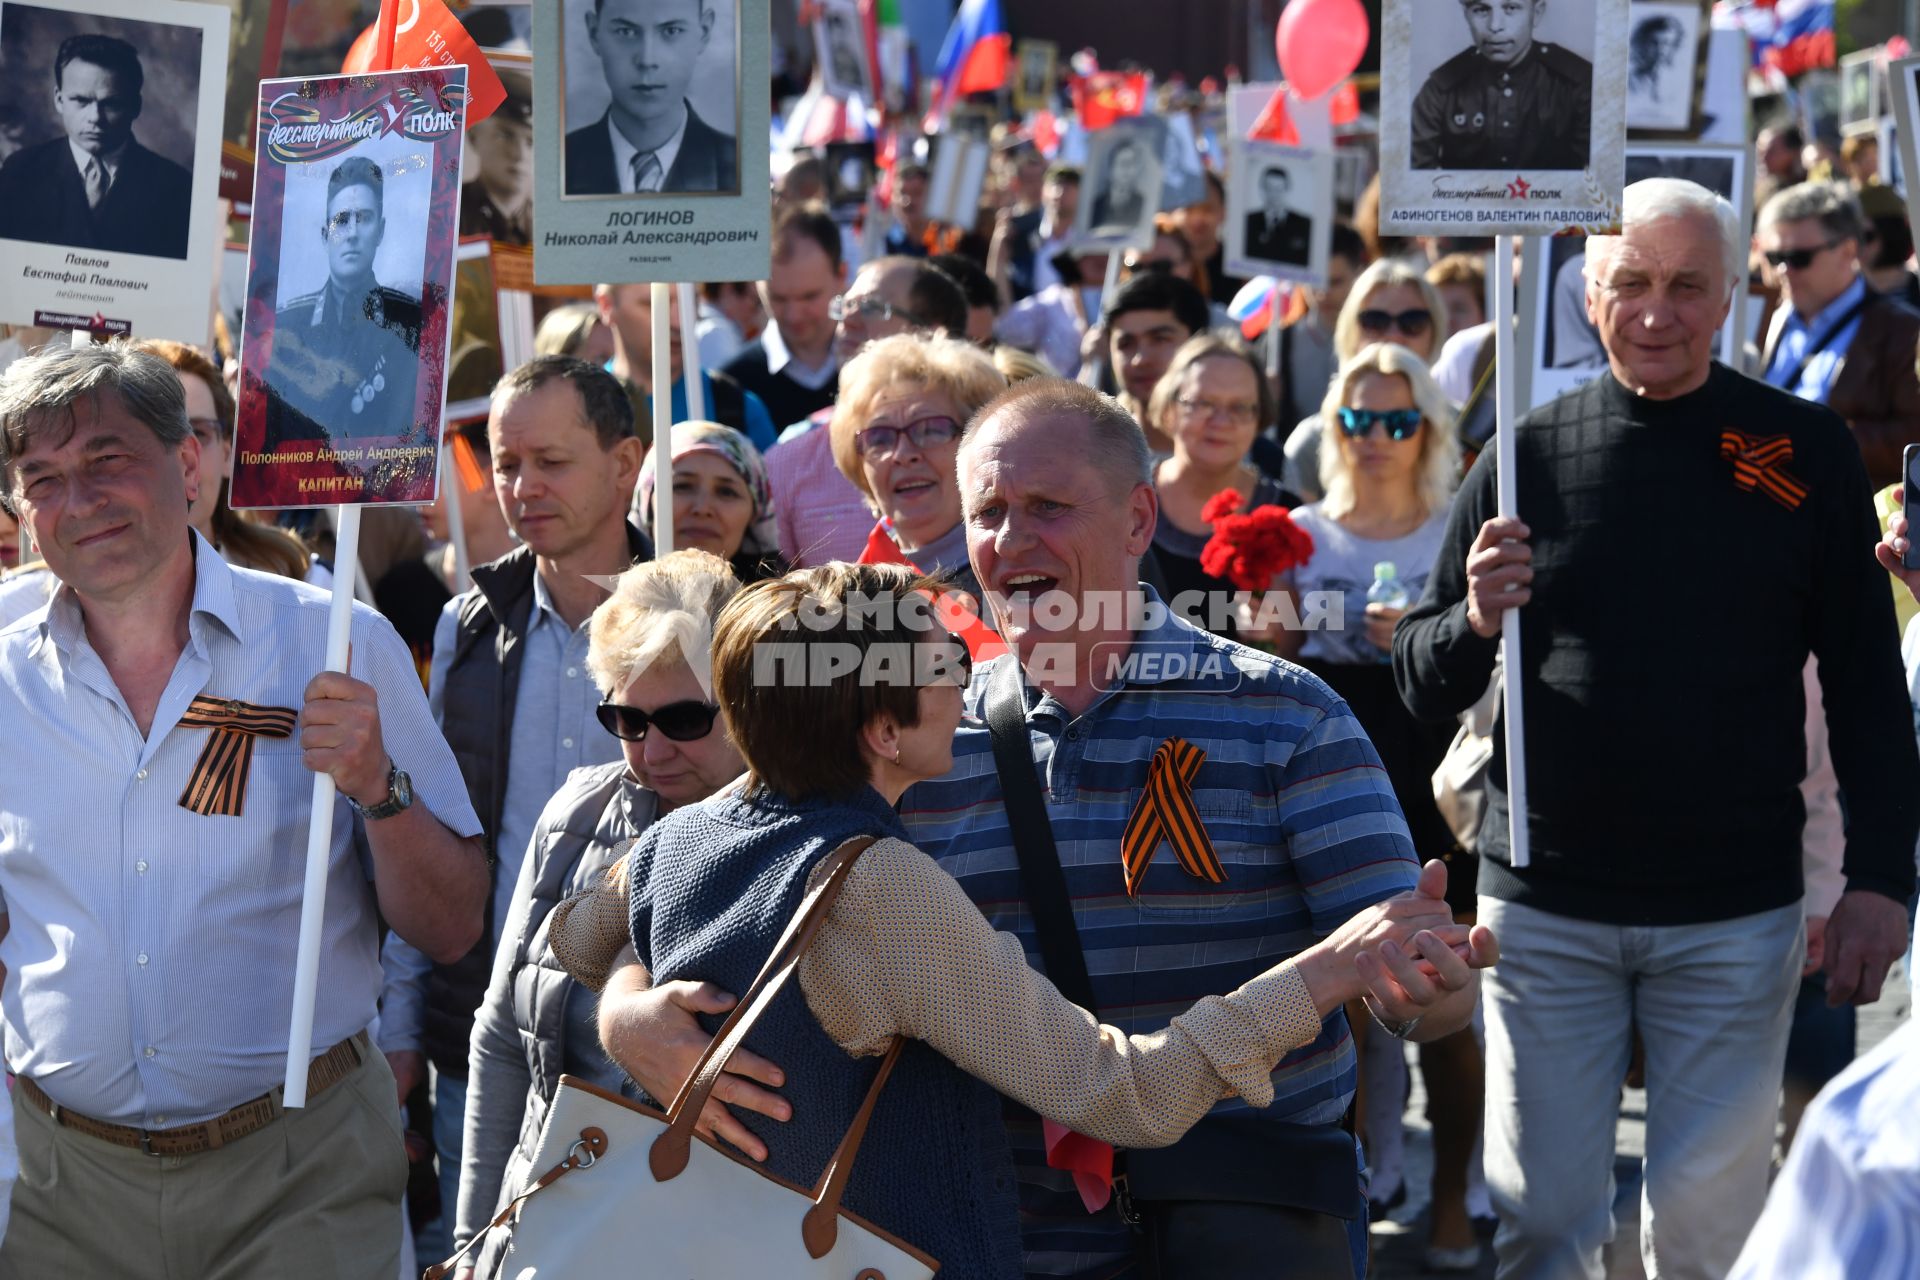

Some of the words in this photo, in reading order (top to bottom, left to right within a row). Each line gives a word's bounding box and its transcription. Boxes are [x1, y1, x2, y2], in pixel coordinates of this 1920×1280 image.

[425, 30, 446, 54] 150
[606, 210, 694, 227] ЛОГИНОВ
[1391, 210, 1473, 222] АФИНОГЕНОВ
[1477, 210, 1540, 222] ВАЛЕНТИН
[1544, 210, 1610, 222] ПАВЛОВИЧ
[544, 231, 618, 246] Николай
[622, 229, 758, 246] Александрович
[65, 253, 109, 269] Павлов
[23, 265, 86, 284] Евстафий
[89, 274, 149, 291] Павлович
[240, 450, 314, 465] Полонников
[316, 447, 363, 463] Андрей
[367, 446, 434, 461] Андреевич
[298, 476, 364, 492] КАПИТАН
